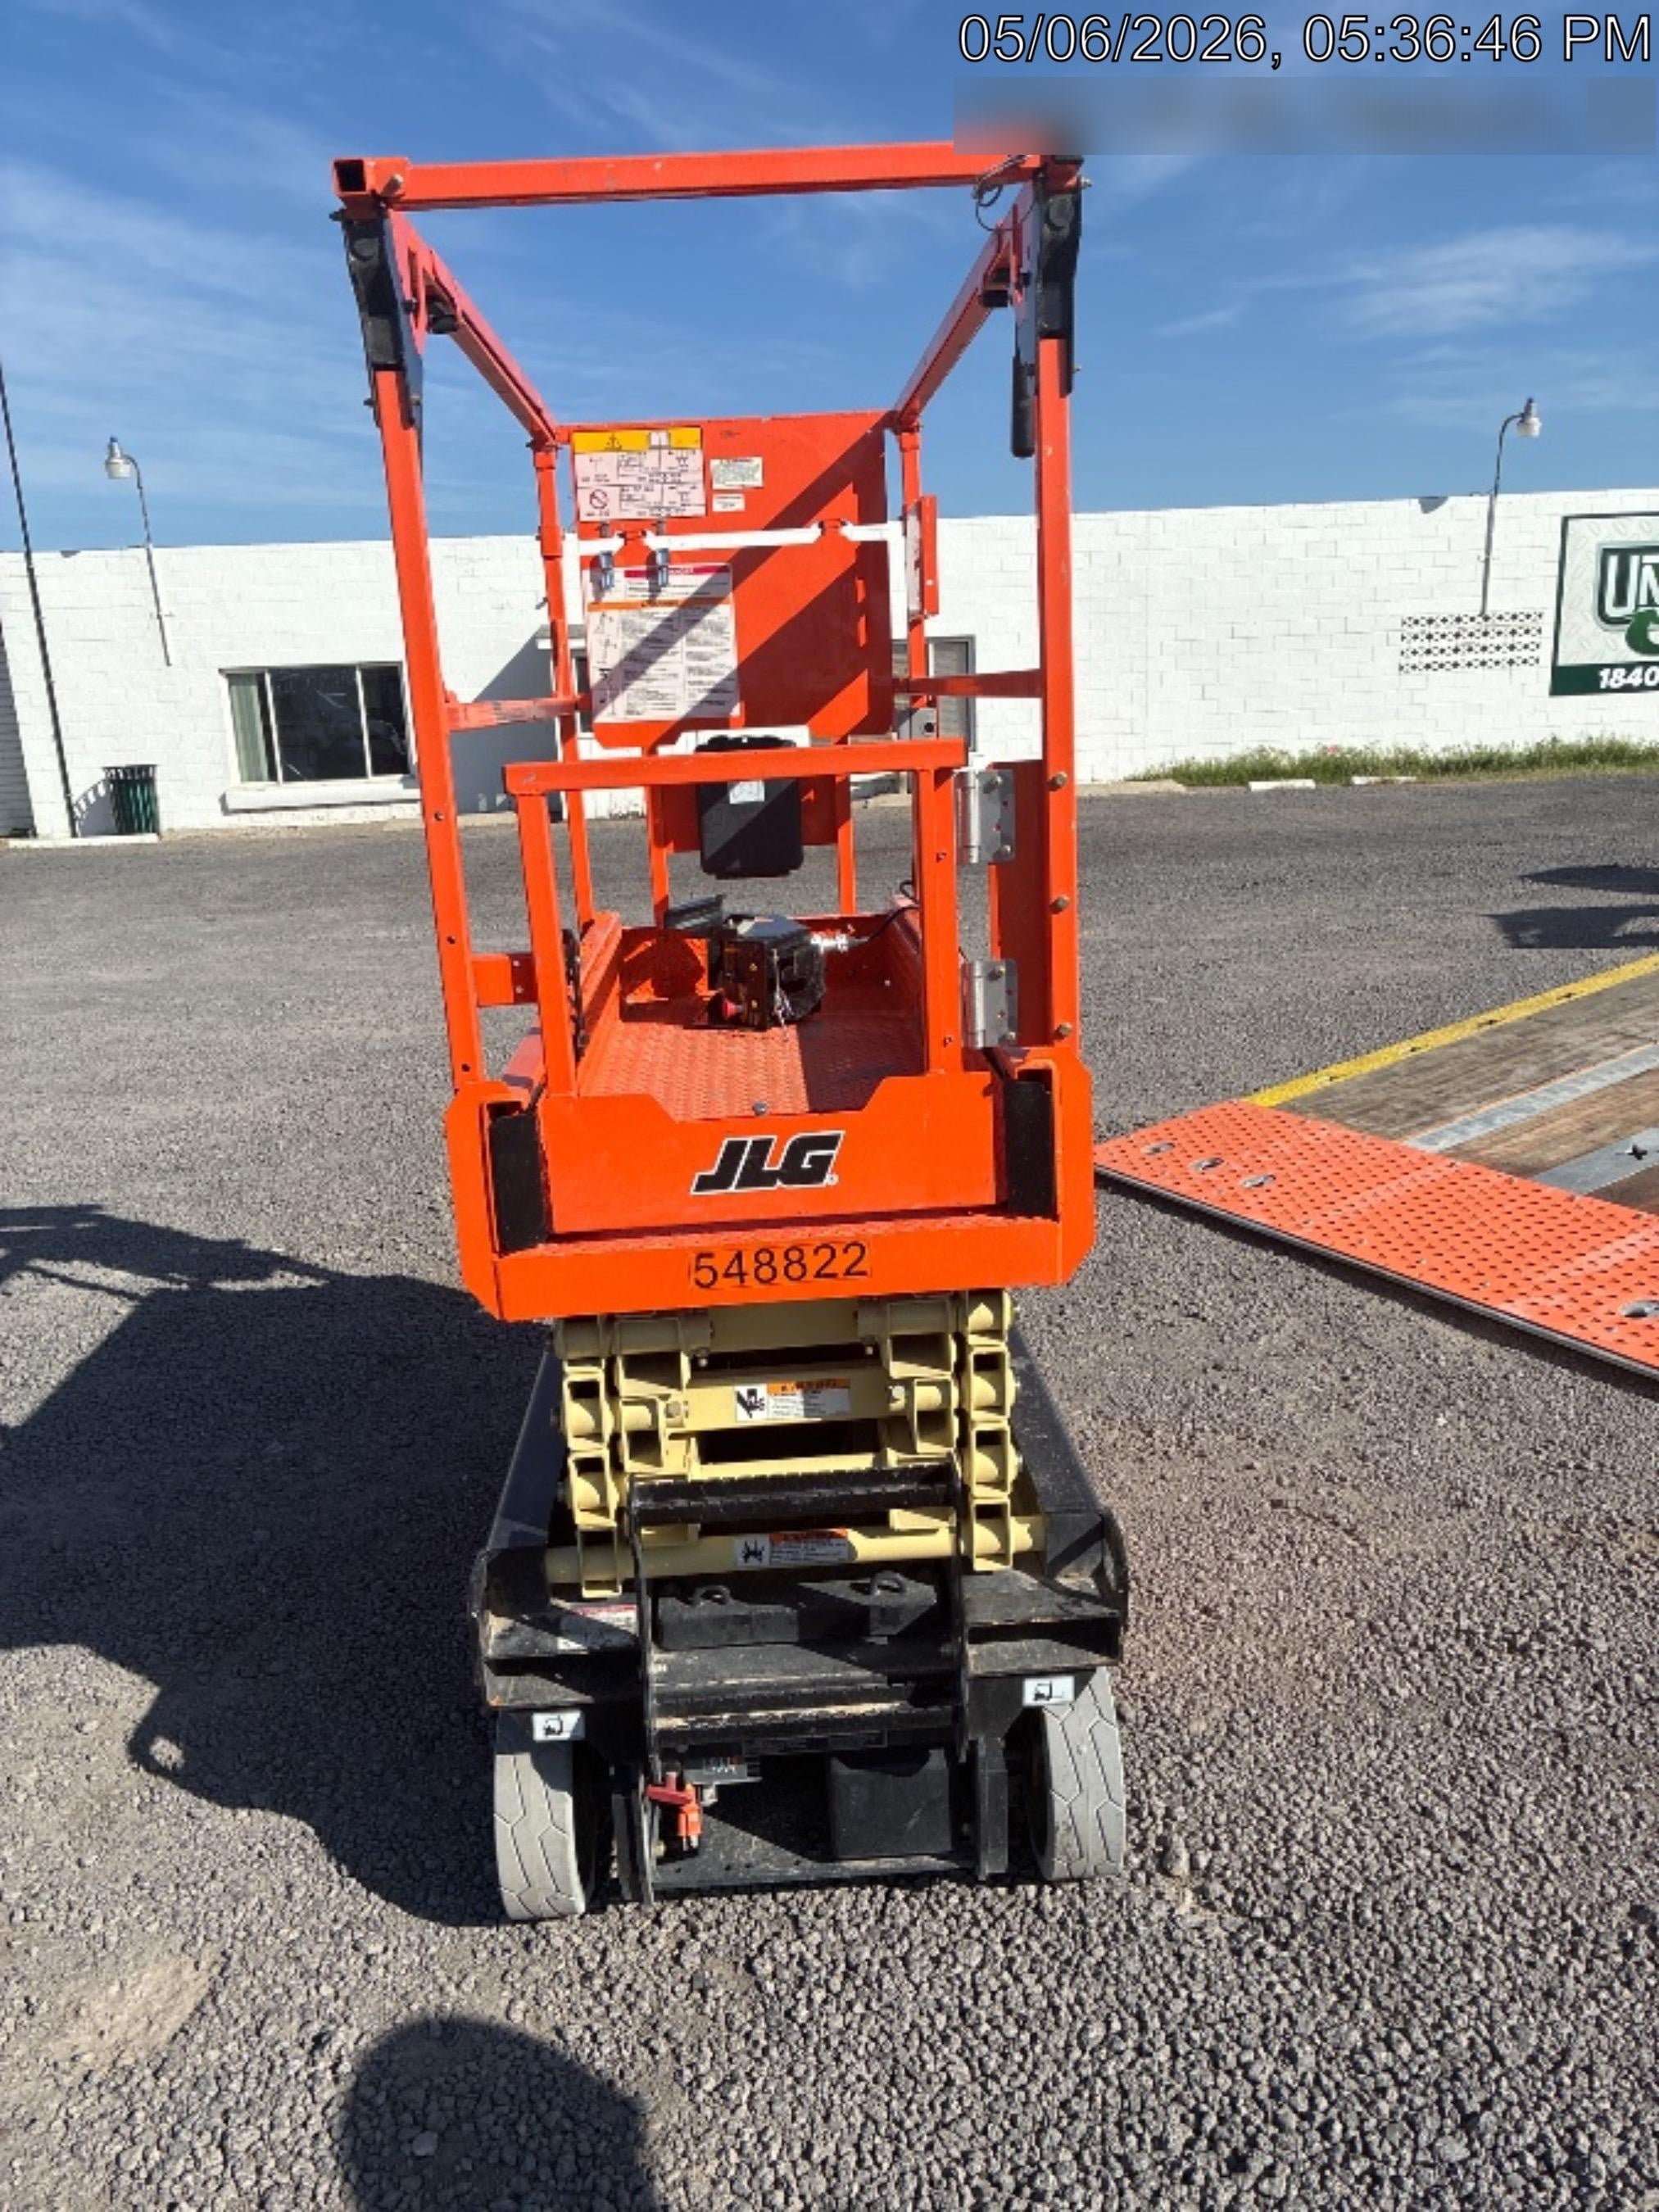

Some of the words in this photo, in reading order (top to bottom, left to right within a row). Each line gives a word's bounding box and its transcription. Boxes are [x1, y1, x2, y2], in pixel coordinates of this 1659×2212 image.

[1599, 664, 1659, 690] 1840
[690, 1130, 845, 1195] JLG
[694, 1241, 868, 1289] 548822
